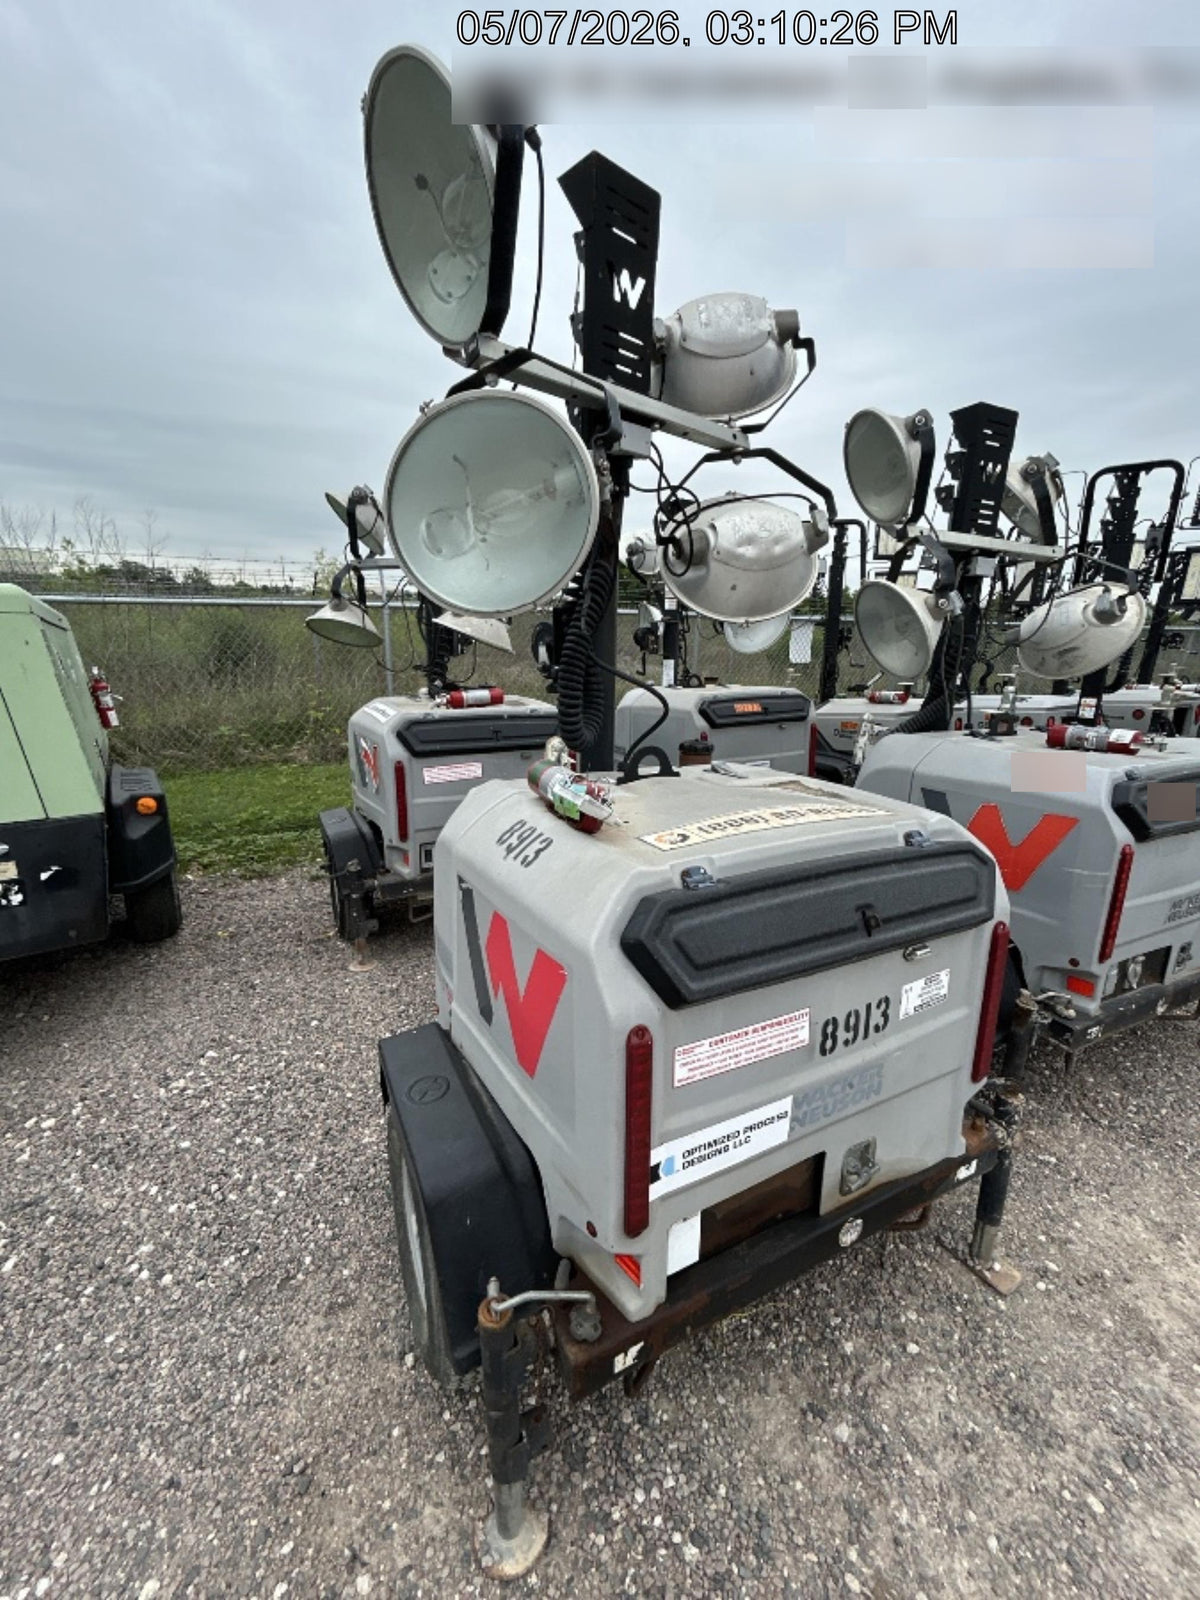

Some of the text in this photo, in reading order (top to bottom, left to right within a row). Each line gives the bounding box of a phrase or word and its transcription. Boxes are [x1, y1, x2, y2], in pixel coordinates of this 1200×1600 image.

[495, 819, 554, 868] 8913
[819, 995, 890, 1057] 8913
[681, 1110, 789, 1160] OPTIMIZED PROCESS
[681, 1135, 752, 1170] DESIGNS LLC
